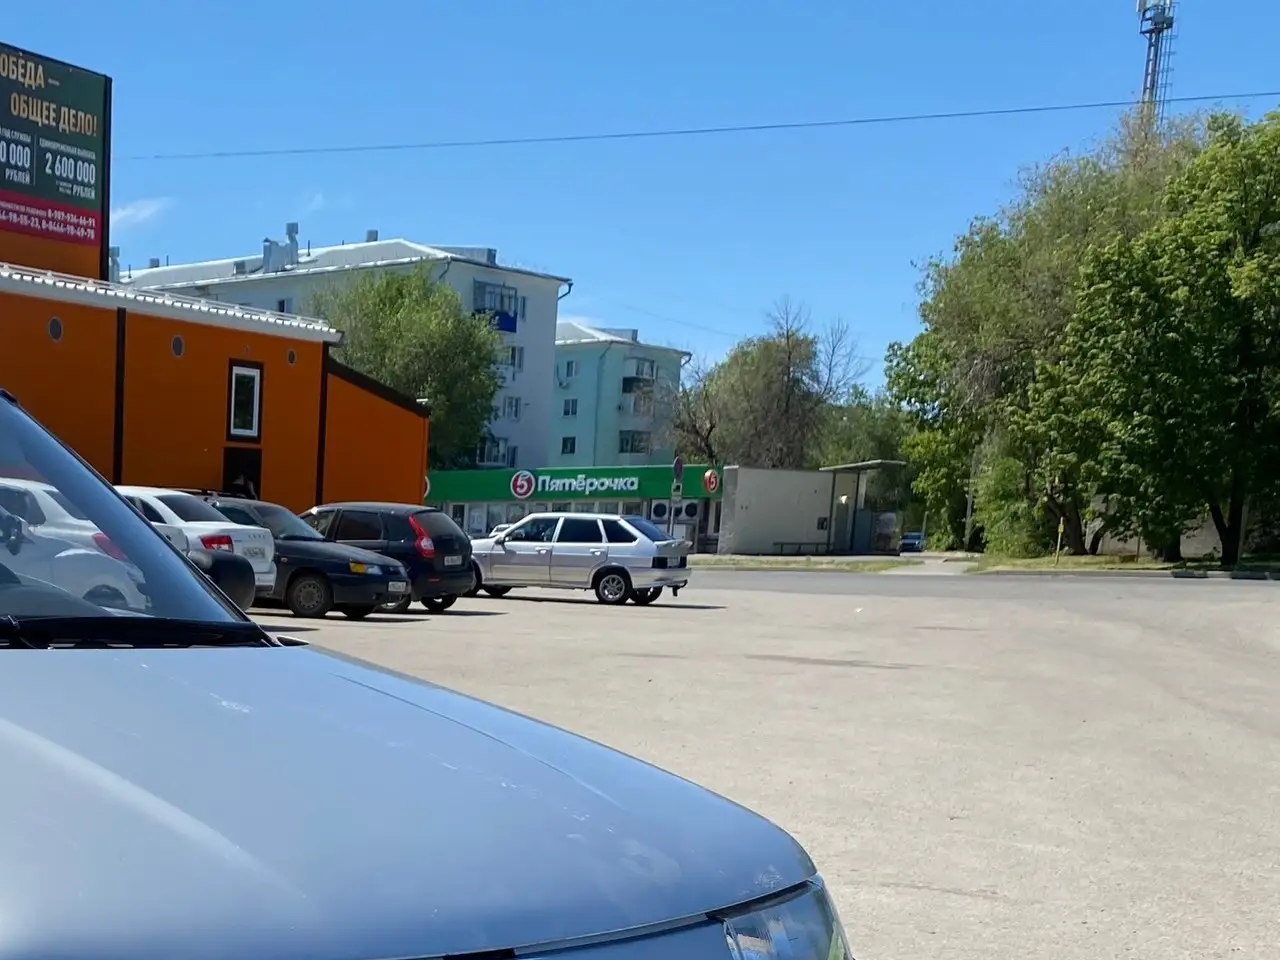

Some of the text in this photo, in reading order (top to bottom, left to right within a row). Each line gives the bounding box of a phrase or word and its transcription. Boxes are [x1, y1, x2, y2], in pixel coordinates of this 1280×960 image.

[10, 92, 98, 137] ОБЩЕЕ ДЕЛО!
[9, 143, 31, 168] 000
[5, 167, 31, 185] РУБЛЕЙ
[45, 152, 96, 185] 2 600 000
[72, 184, 96, 199] РУБЛЕЙ
[536, 474, 640, 495] Пятёрочка
